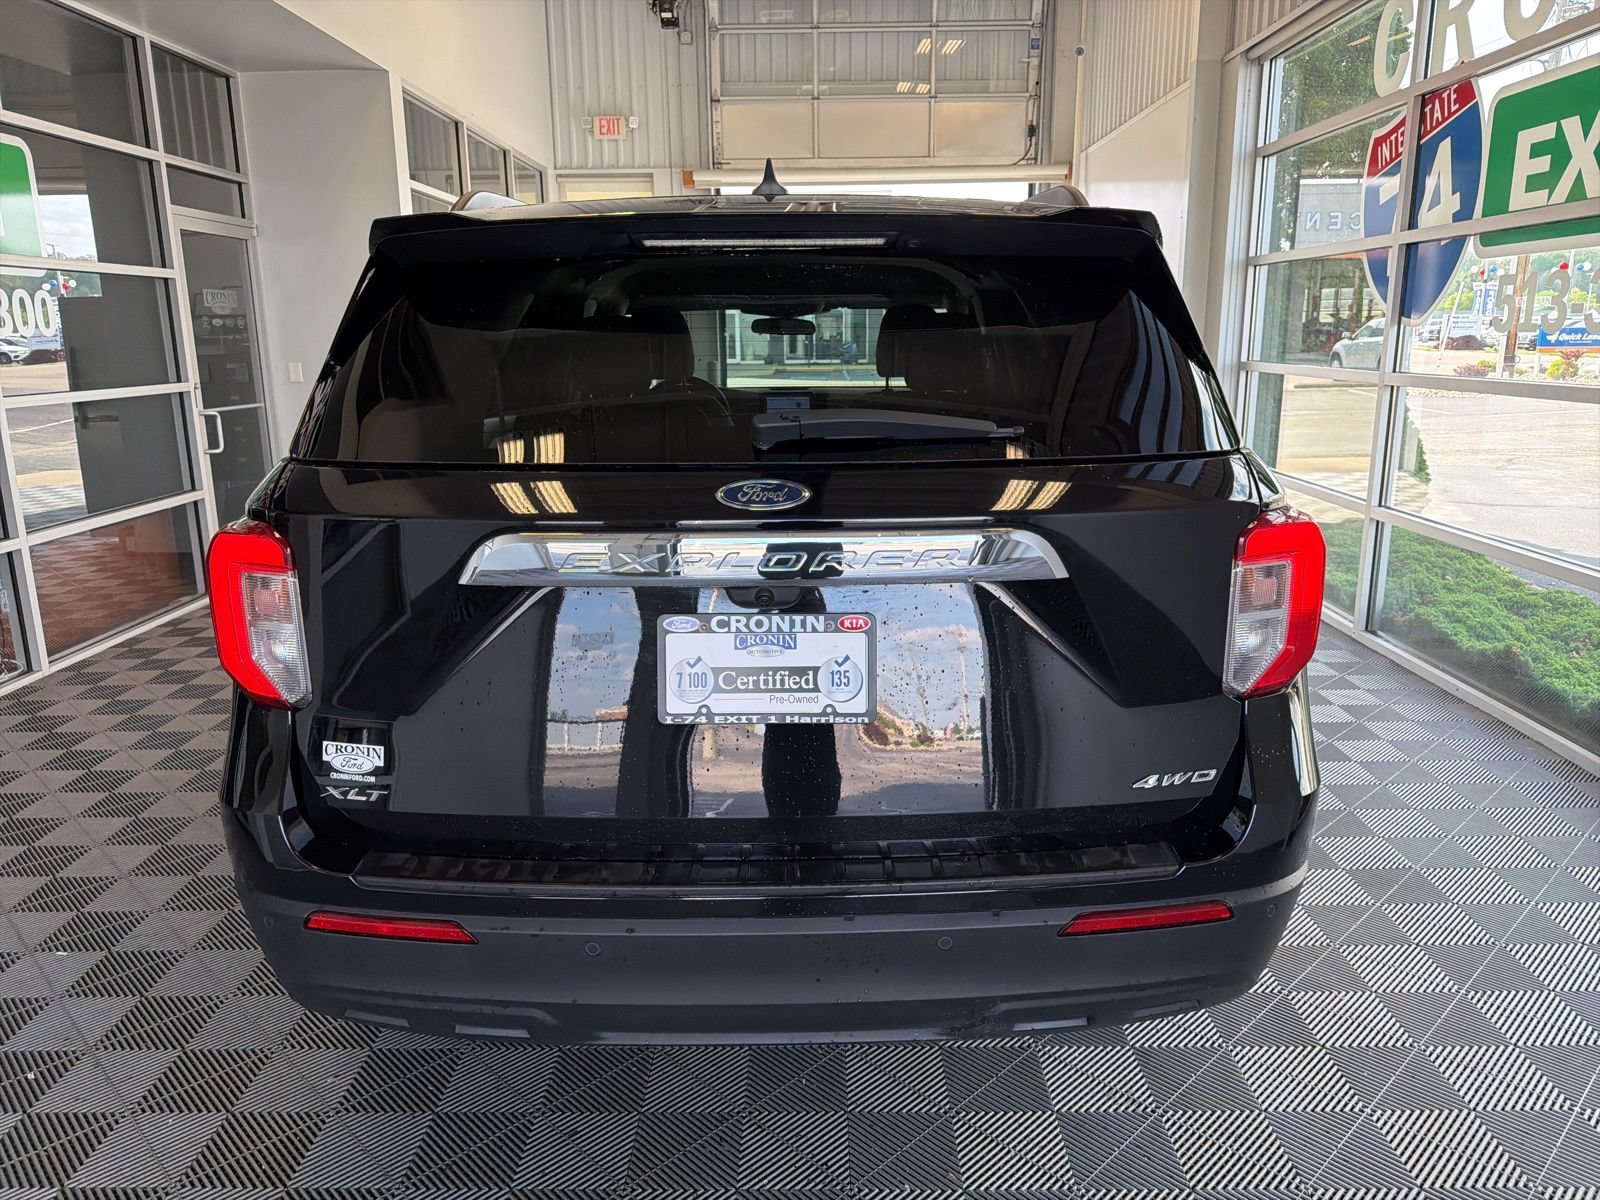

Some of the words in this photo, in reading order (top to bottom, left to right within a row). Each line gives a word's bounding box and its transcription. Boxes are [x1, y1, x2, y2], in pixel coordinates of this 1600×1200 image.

[599, 118, 621, 136] EXIT
[1378, 84, 1460, 169] INTETATE
[1559, 333, 1582, 342] Quick
[737, 484, 789, 501] Ford
[557, 549, 962, 573] EXPLORER
[671, 619, 692, 629] Ford
[710, 615, 825, 633] CRONIN
[843, 618, 866, 627] KIA
[735, 633, 796, 649] CRONIN
[718, 671, 815, 690] Certified
[830, 670, 850, 688] 135
[769, 695, 819, 704] Pre-Owned
[664, 715, 708, 724] I-74
[714, 715, 761, 724] EXIT
[768, 715, 779, 724] 1
[785, 715, 869, 724] Harrison
[324, 742, 382, 761] CRONIN
[340, 756, 365, 770] Ford
[330, 772, 376, 784] CRONINFORD.COM
[1131, 769, 1218, 789] 4WD
[319, 786, 390, 802] XLT
